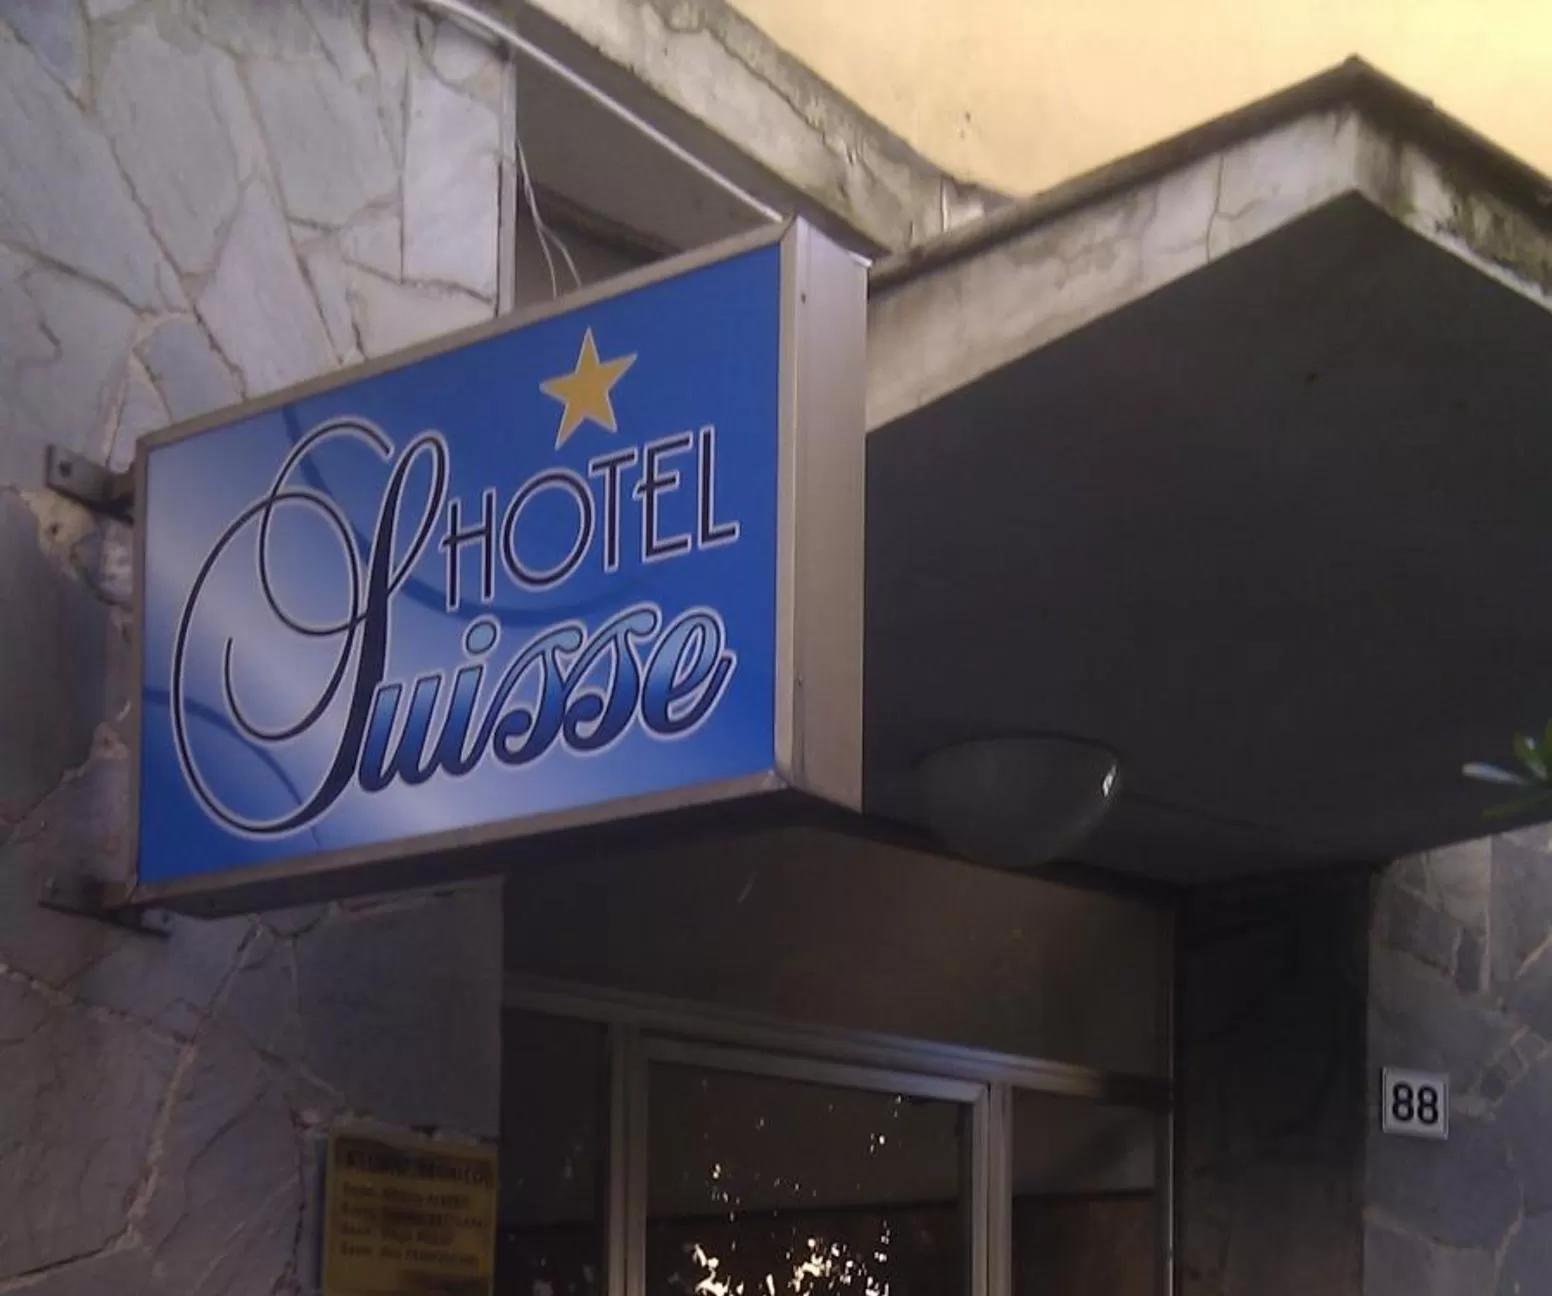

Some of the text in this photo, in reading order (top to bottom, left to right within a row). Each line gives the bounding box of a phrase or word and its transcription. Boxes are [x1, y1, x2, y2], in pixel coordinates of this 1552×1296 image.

[440, 425, 741, 612] HOTEL
[172, 415, 738, 839] Suisse
[1392, 1080, 1439, 1126] 88
